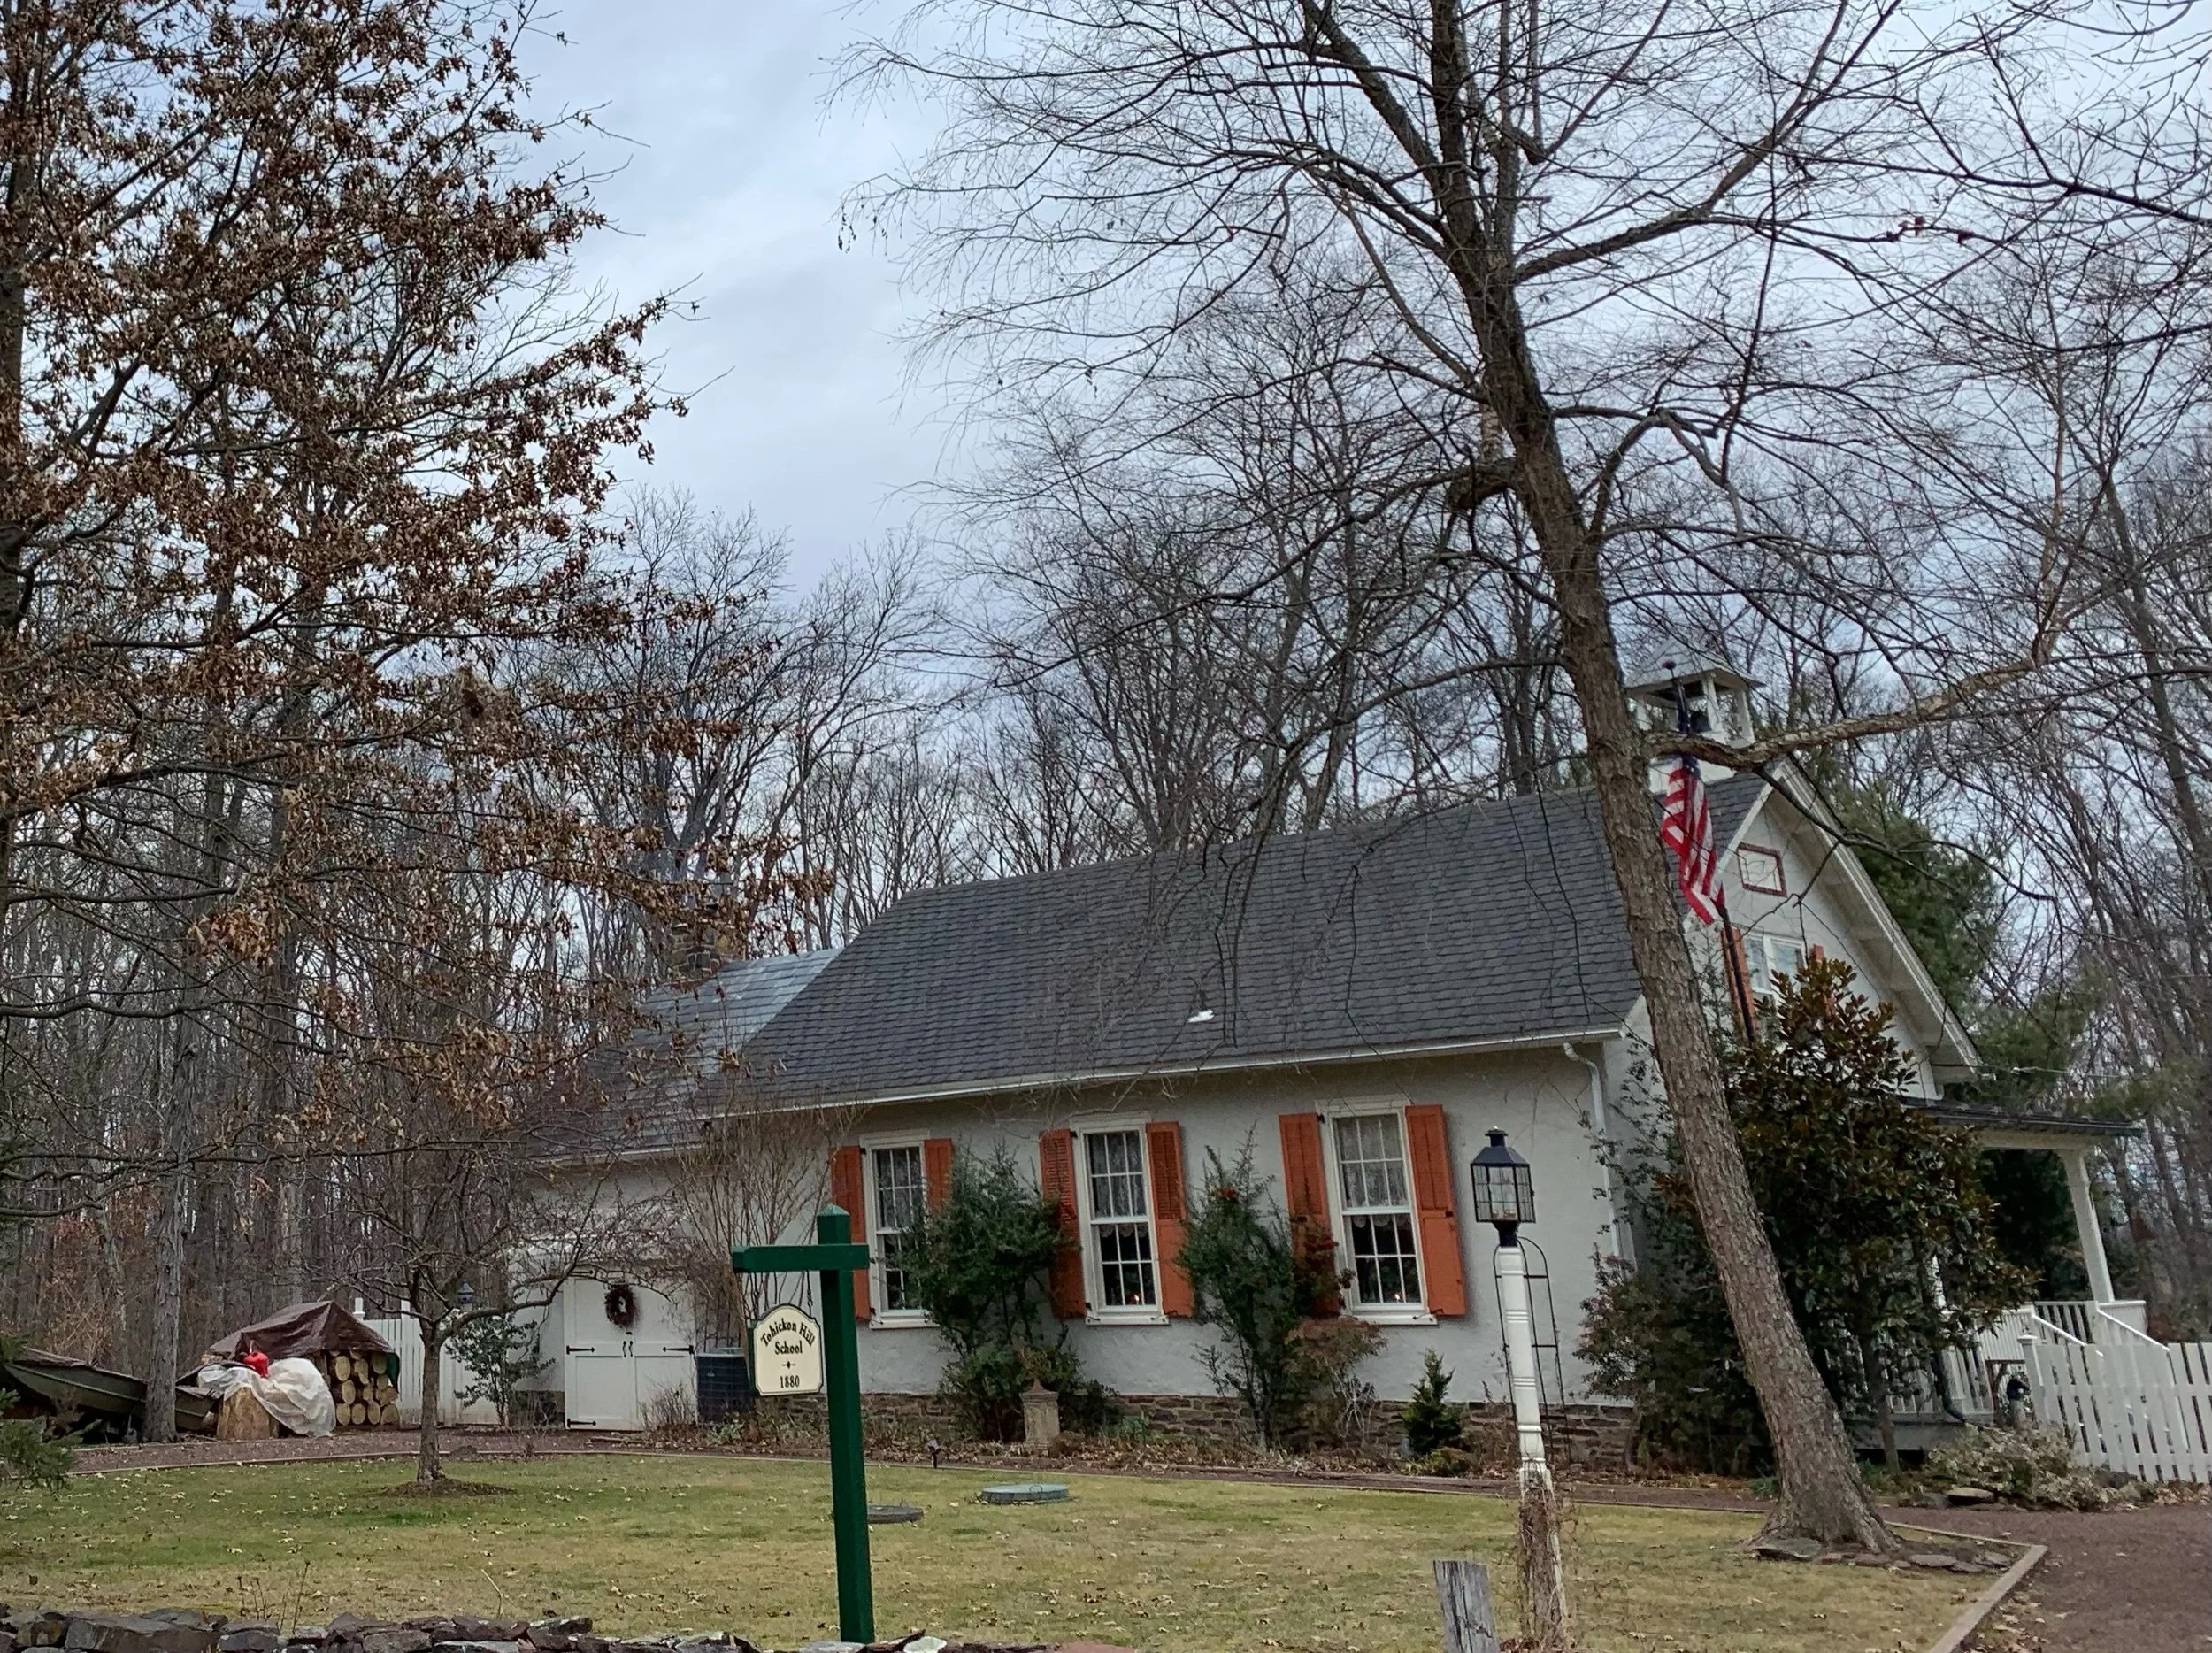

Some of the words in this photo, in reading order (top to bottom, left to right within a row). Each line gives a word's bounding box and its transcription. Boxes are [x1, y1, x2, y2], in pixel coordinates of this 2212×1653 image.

[760, 1317, 797, 1347] Tohickon
[798, 1322, 816, 1347] Hill
[774, 1340, 803, 1355] School
[780, 1374, 800, 1388] 1880
